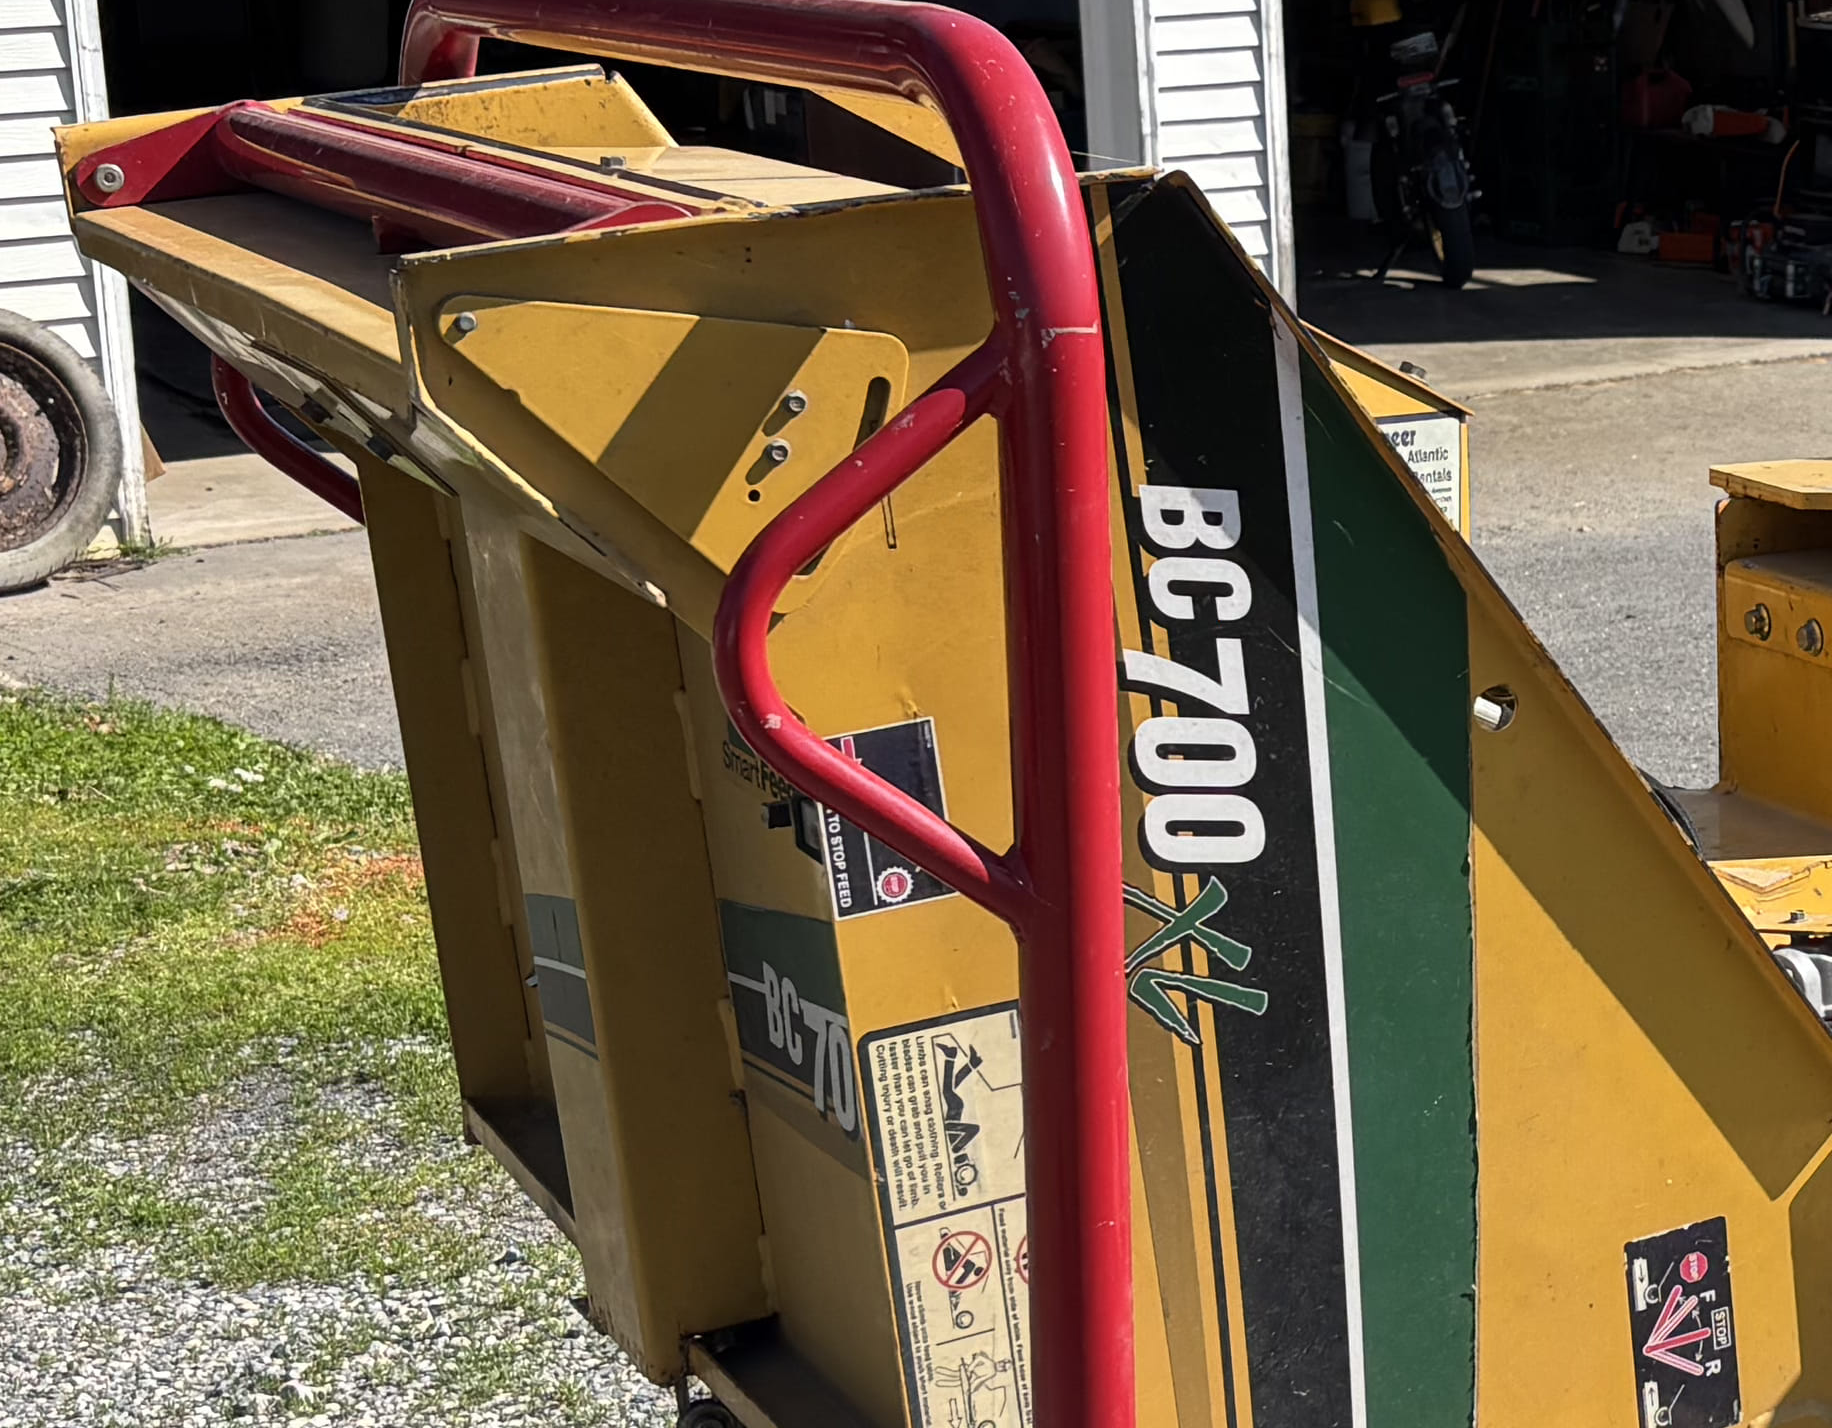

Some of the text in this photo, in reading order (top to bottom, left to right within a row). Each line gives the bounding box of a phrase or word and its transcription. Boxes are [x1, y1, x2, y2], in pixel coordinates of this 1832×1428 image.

[1385, 429, 1416, 447] eer
[1407, 446, 1449, 463] Atlantic
[1123, 483, 1267, 865] BC700
[826, 812, 852, 908] TO STOP FEED
[763, 960, 856, 1132] BC70
[874, 1043, 888, 1081] Cutting
[920, 1068, 929, 1087] can
[895, 1098, 905, 1117] you
[903, 1155, 912, 1168] go
[908, 1095, 920, 1118] grab
[919, 1163, 929, 1182] you
[1699, 1289, 1716, 1302] F
[1714, 1311, 1729, 1347] STOP
[1704, 1359, 1722, 1377] R
